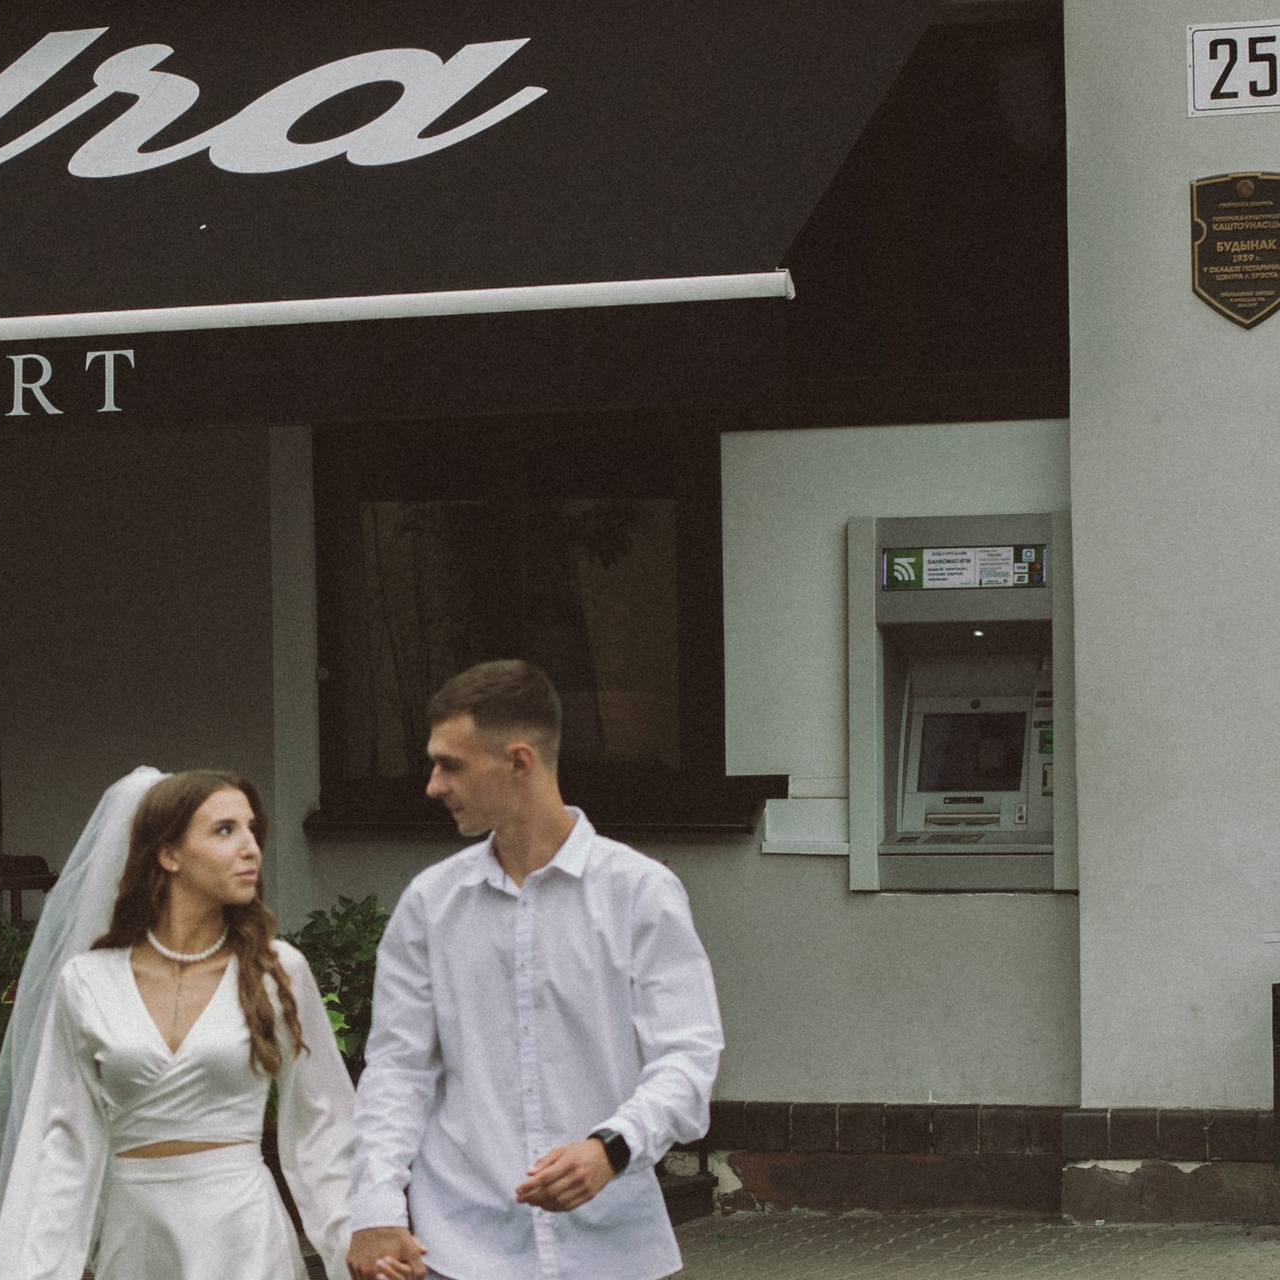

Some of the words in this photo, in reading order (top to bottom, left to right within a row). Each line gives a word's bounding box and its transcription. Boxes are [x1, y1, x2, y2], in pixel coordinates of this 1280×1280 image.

[1209, 35, 1278, 100] 25
[1216, 239, 1277, 252] БУДЫНАК
[1232, 254, 1254, 263] 1939
